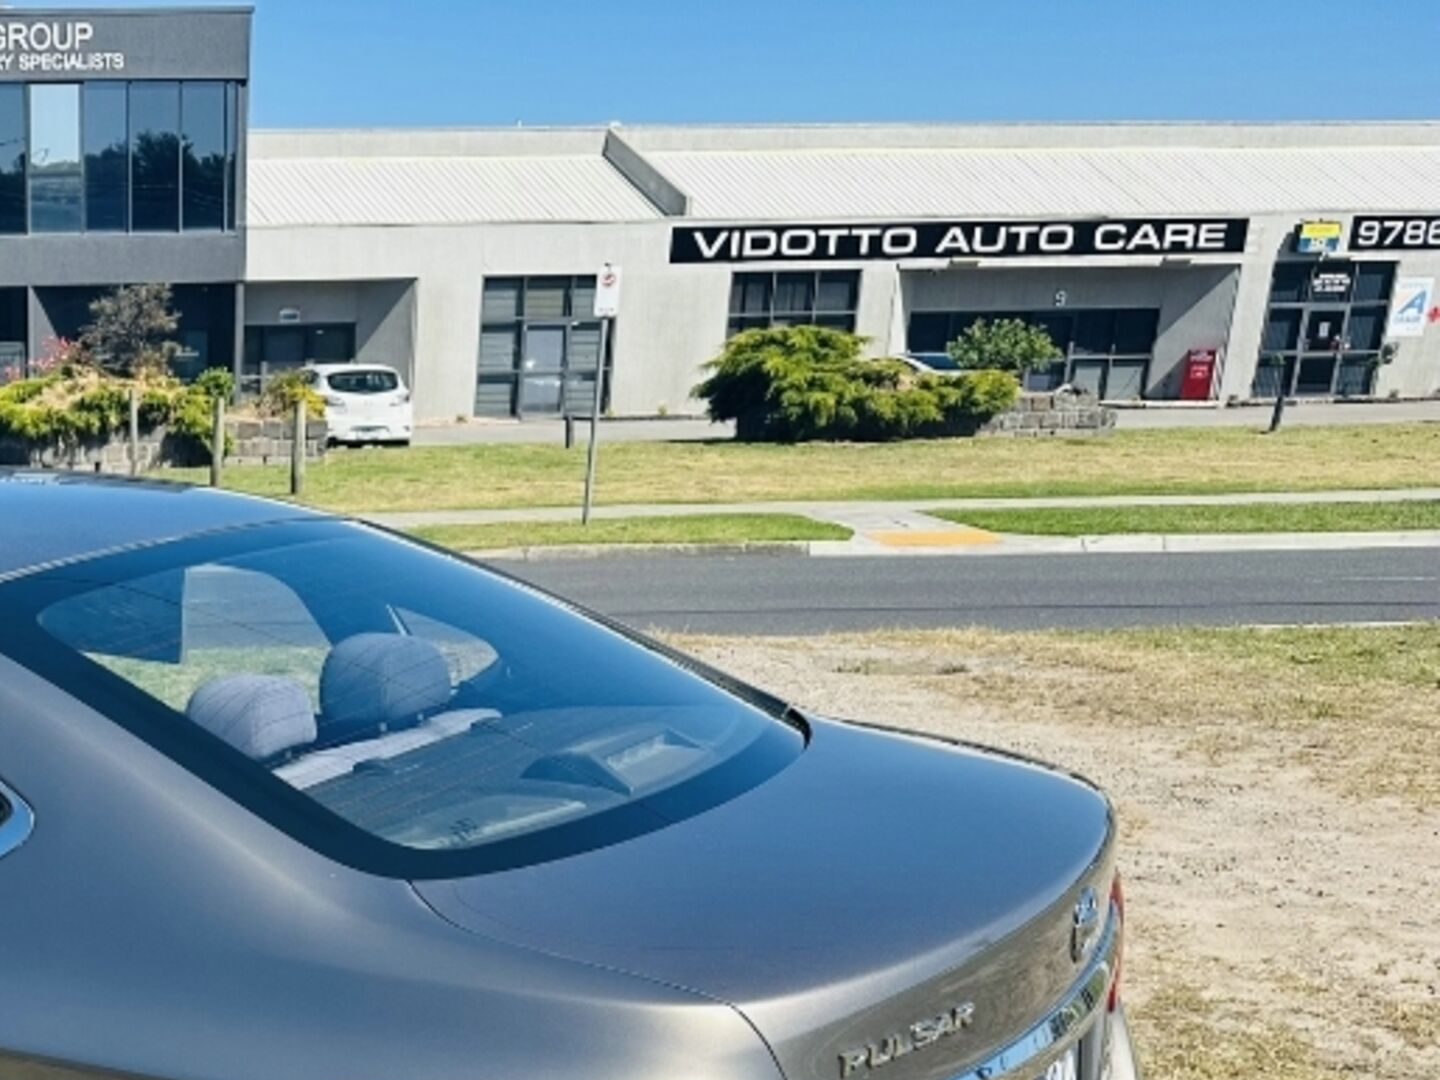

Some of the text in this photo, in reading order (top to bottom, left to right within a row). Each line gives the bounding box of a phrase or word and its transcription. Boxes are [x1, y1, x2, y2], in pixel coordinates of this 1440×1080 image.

[18, 52, 125, 71] SPECIALISTS
[692, 222, 1229, 258] VIDOTTO AUTO CARE
[837, 1001, 976, 1080] PULSAR
